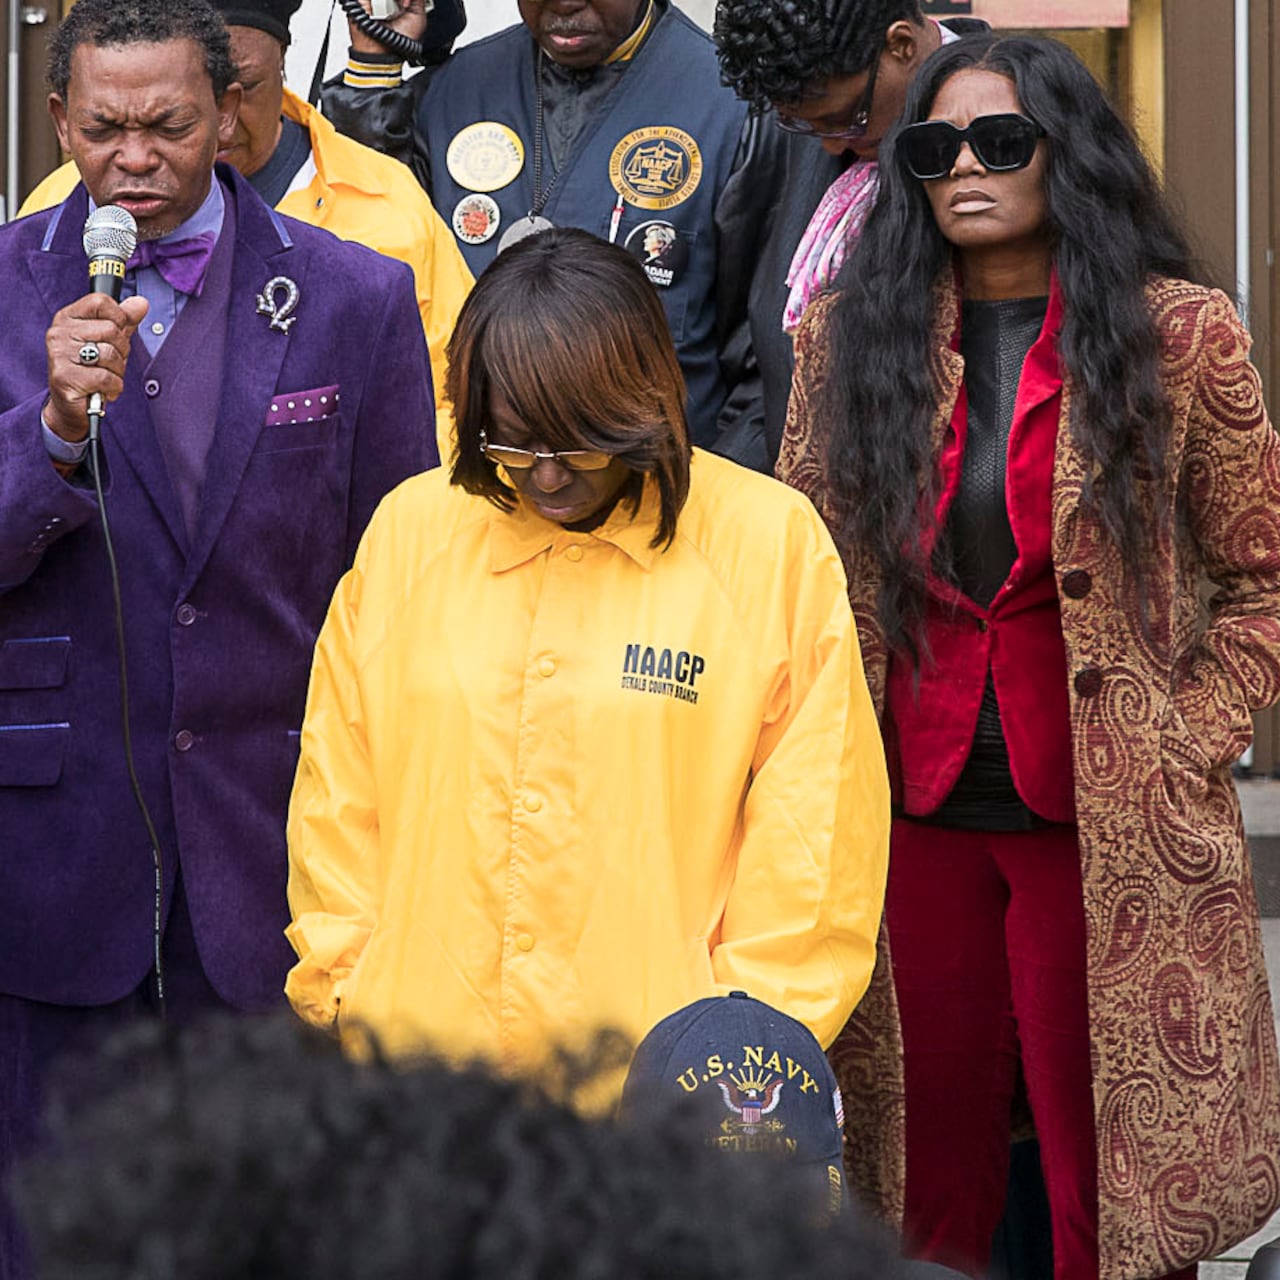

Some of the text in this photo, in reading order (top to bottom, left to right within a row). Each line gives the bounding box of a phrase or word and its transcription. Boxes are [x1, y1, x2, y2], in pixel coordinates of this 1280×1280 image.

[641, 157, 673, 171] NAACP
[622, 643, 705, 687] NAACP
[621, 676, 699, 705] DEKALB COUNTY BRANCH
[676, 1046, 820, 1094] U.S. NAVY
